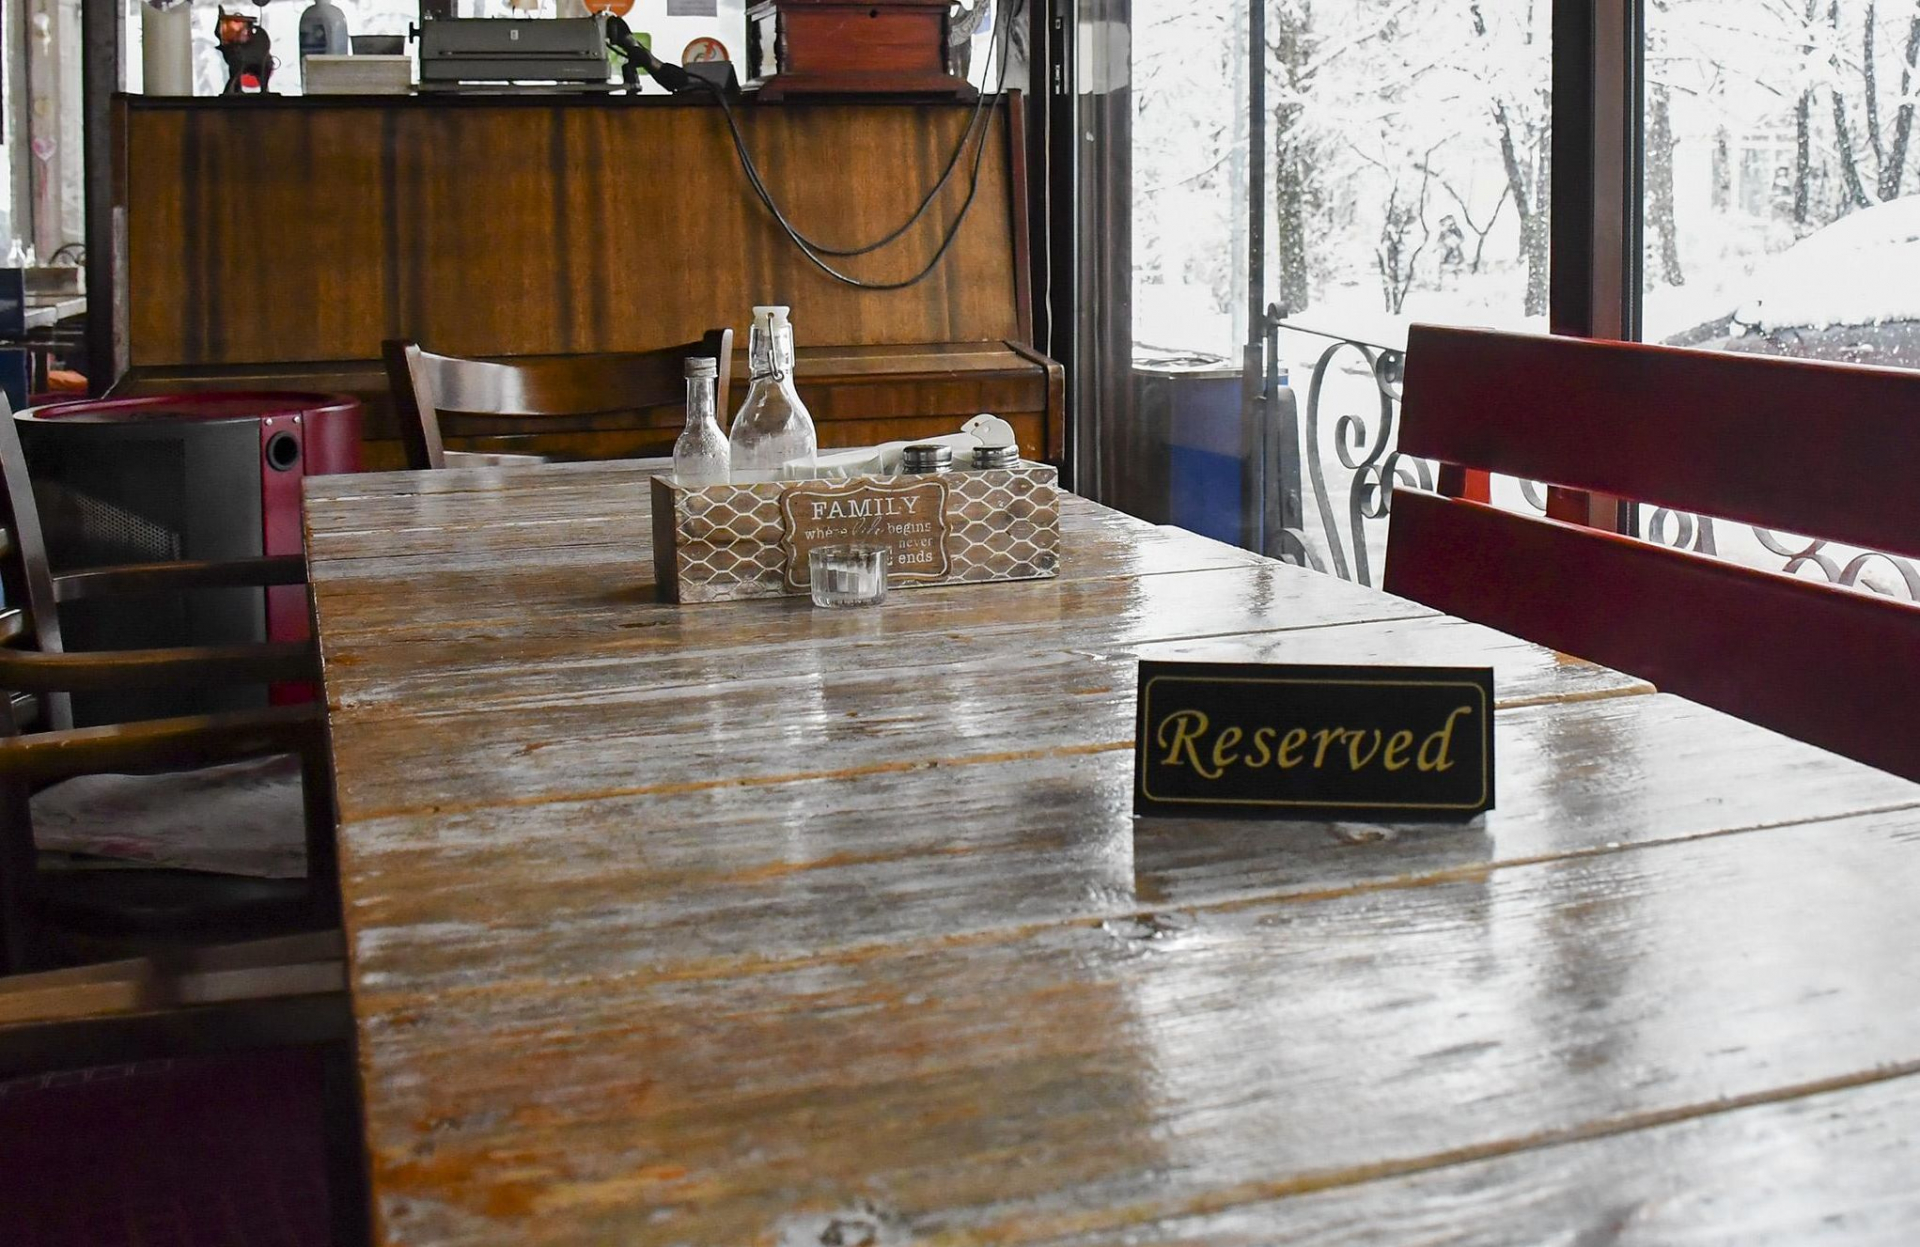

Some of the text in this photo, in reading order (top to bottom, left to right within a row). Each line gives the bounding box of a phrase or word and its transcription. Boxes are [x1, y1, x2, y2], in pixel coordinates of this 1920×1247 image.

[811, 496, 920, 520] FAMILY
[887, 522, 931, 536] begins
[898, 537, 933, 549] never
[898, 551, 933, 564] ends
[1157, 706, 1472, 779] Reserved
